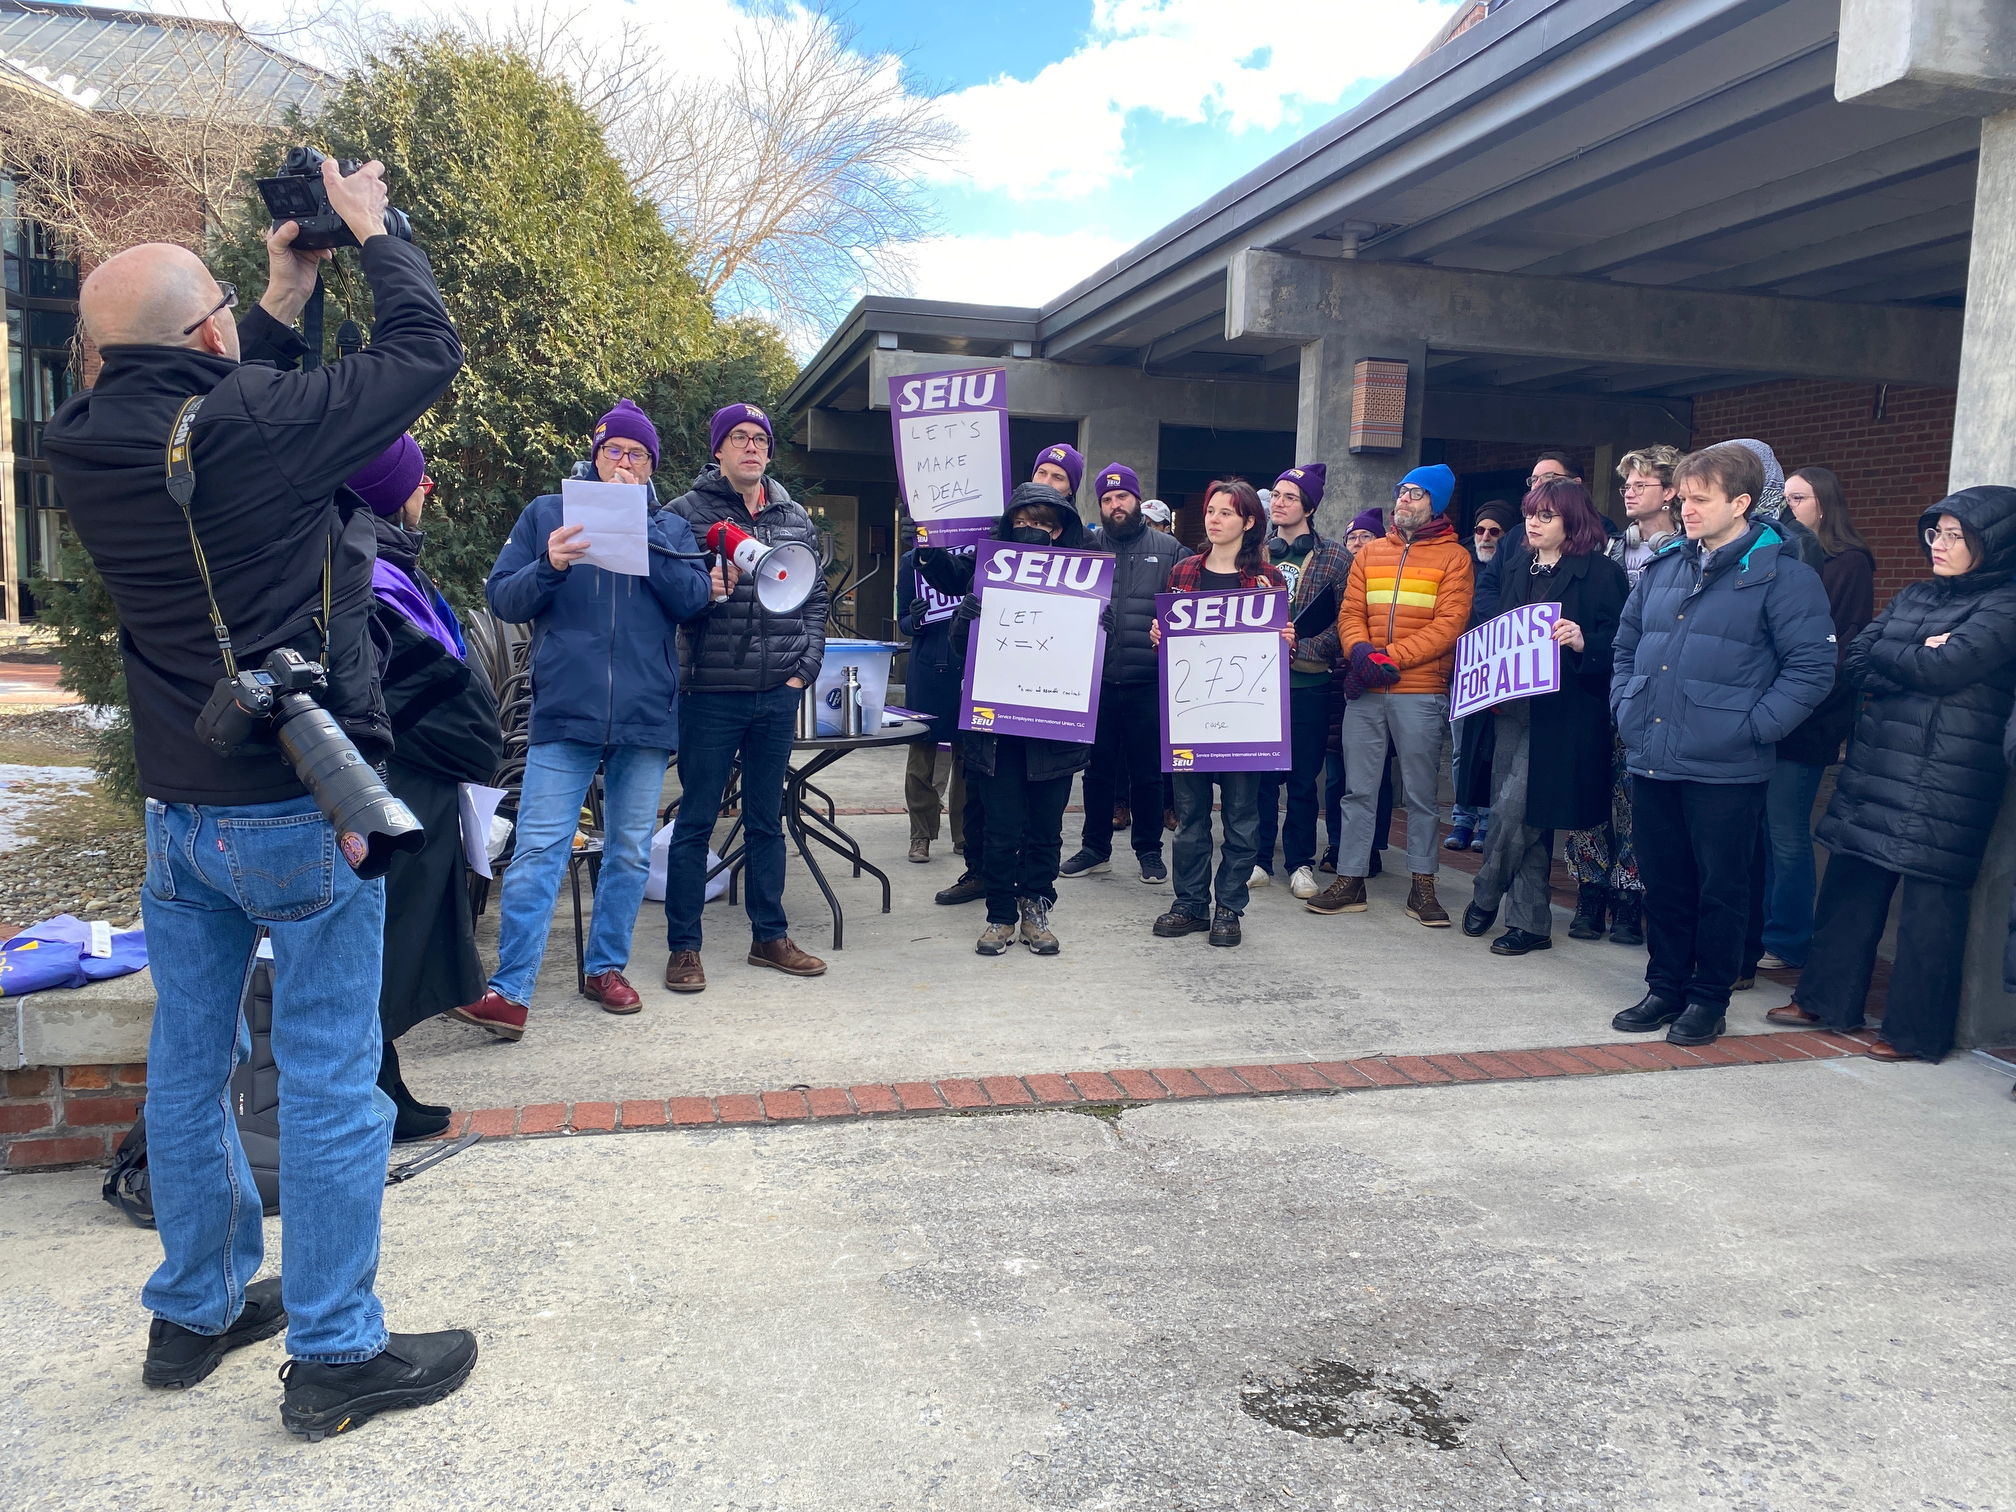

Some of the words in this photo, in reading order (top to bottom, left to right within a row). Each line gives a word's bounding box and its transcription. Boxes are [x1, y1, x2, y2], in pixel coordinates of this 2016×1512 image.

[900, 374, 996, 412] SEIU
[174, 413, 196, 446] NPS
[911, 420, 981, 440] LET'S
[917, 454, 968, 473] MAKE
[912, 489, 920, 503] A
[928, 478, 979, 502] DEAL
[987, 549, 1103, 591] SEIU
[999, 607, 1043, 627] LET
[1169, 594, 1276, 631] SEIU
[1198, 639, 1206, 648] A
[1459, 604, 1553, 670] UNIONS
[1174, 653, 1277, 704] 2.75%
[1459, 663, 1490, 704] FOR
[1494, 648, 1550, 698] ALL
[971, 717, 994, 727] SEIU
[1034, 717, 1061, 725] International
[1172, 759, 1194, 767] SEIU
